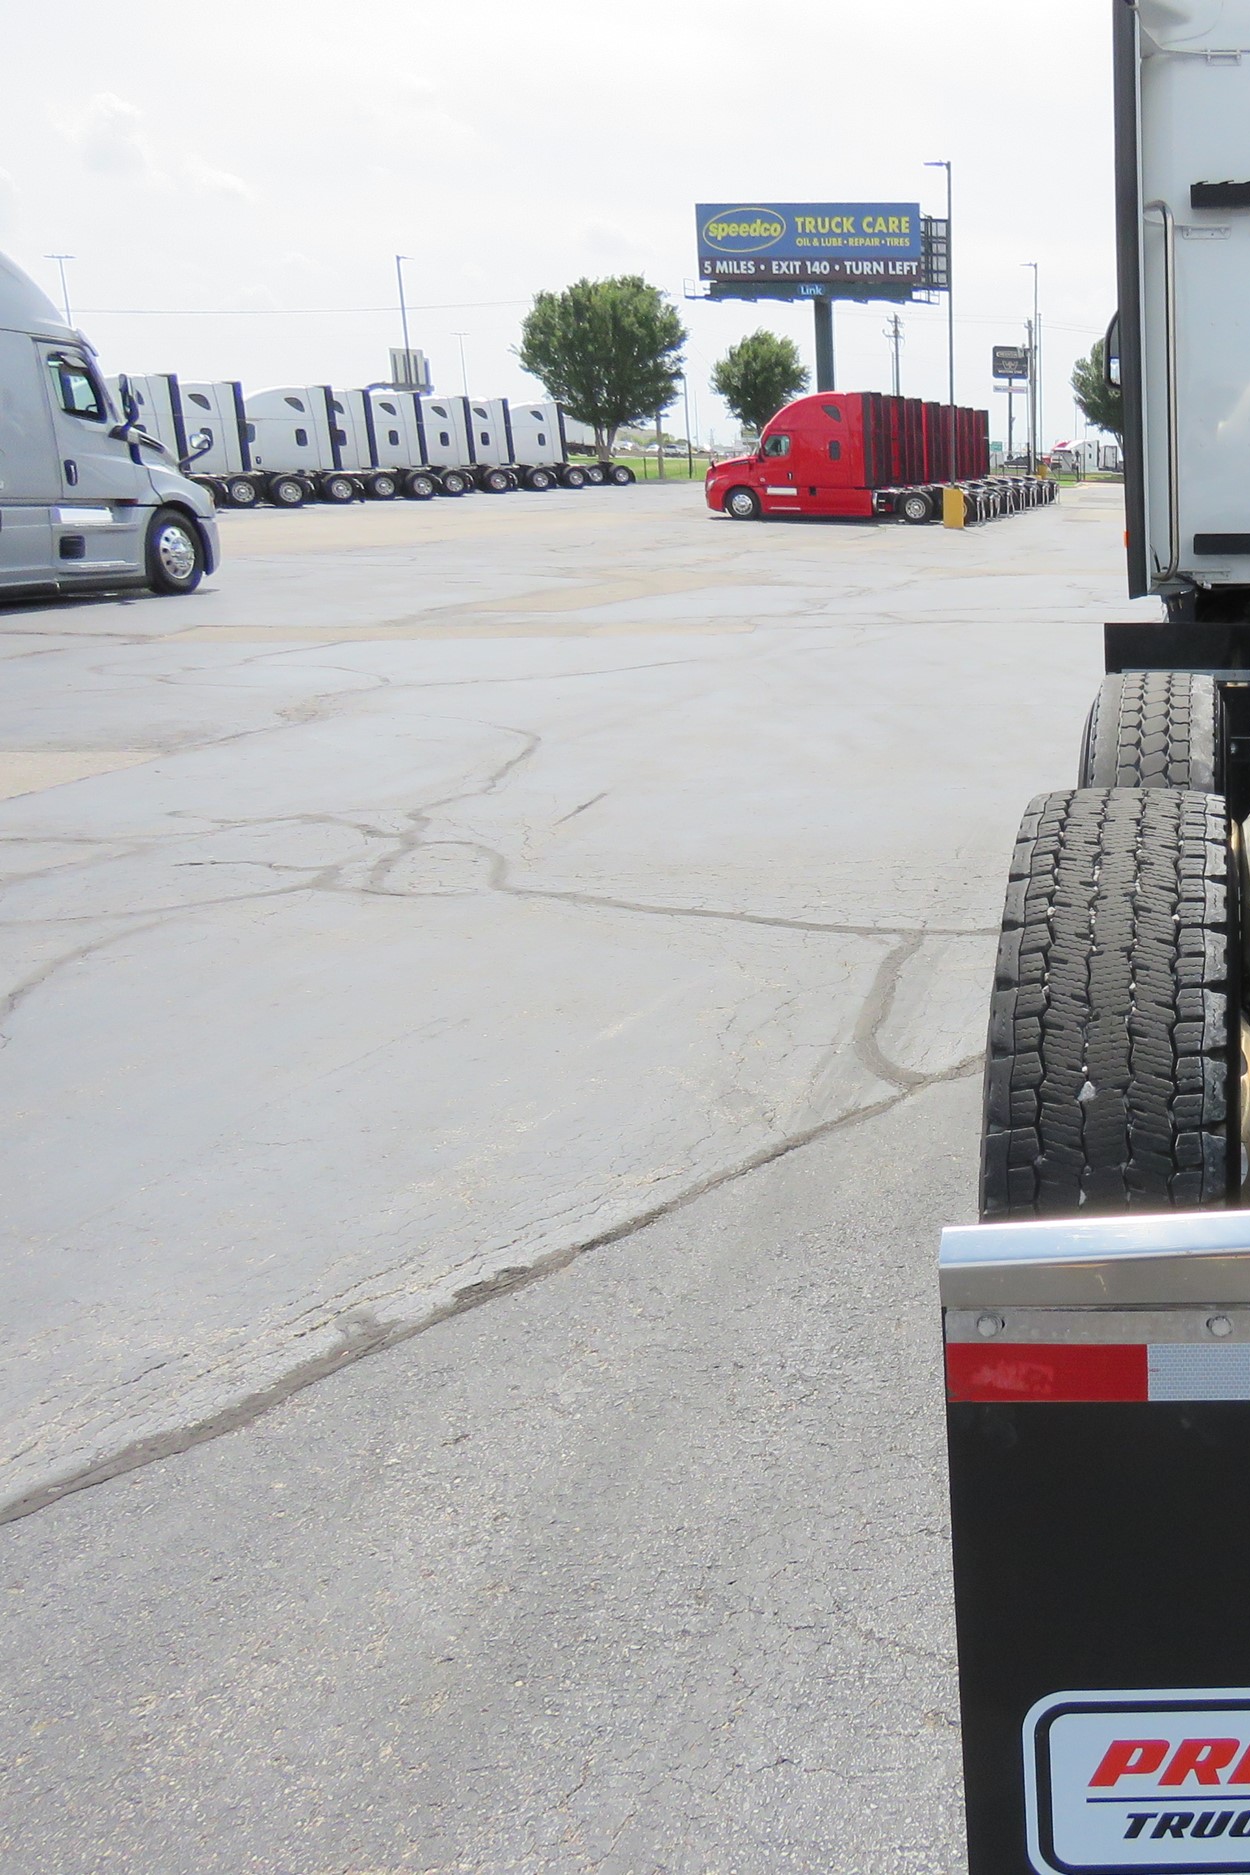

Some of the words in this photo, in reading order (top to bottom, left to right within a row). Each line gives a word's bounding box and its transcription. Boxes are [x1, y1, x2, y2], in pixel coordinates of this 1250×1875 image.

[709, 219, 780, 240] speedco
[795, 216, 855, 233] TRUCK
[862, 216, 910, 233] CARE
[795, 237, 811, 247] OIL
[812, 237, 820, 247] &
[821, 237, 843, 247] LUBE
[848, 237, 880, 247] REPAIR
[886, 237, 911, 247] TIRES
[703, 260, 712, 274] 5
[715, 260, 756, 275] MILES
[771, 260, 802, 275] EXIT
[805, 260, 831, 275] 140
[843, 260, 885, 275] TURN
[888, 260, 919, 276] LEFT
[800, 285, 823, 296] Link
